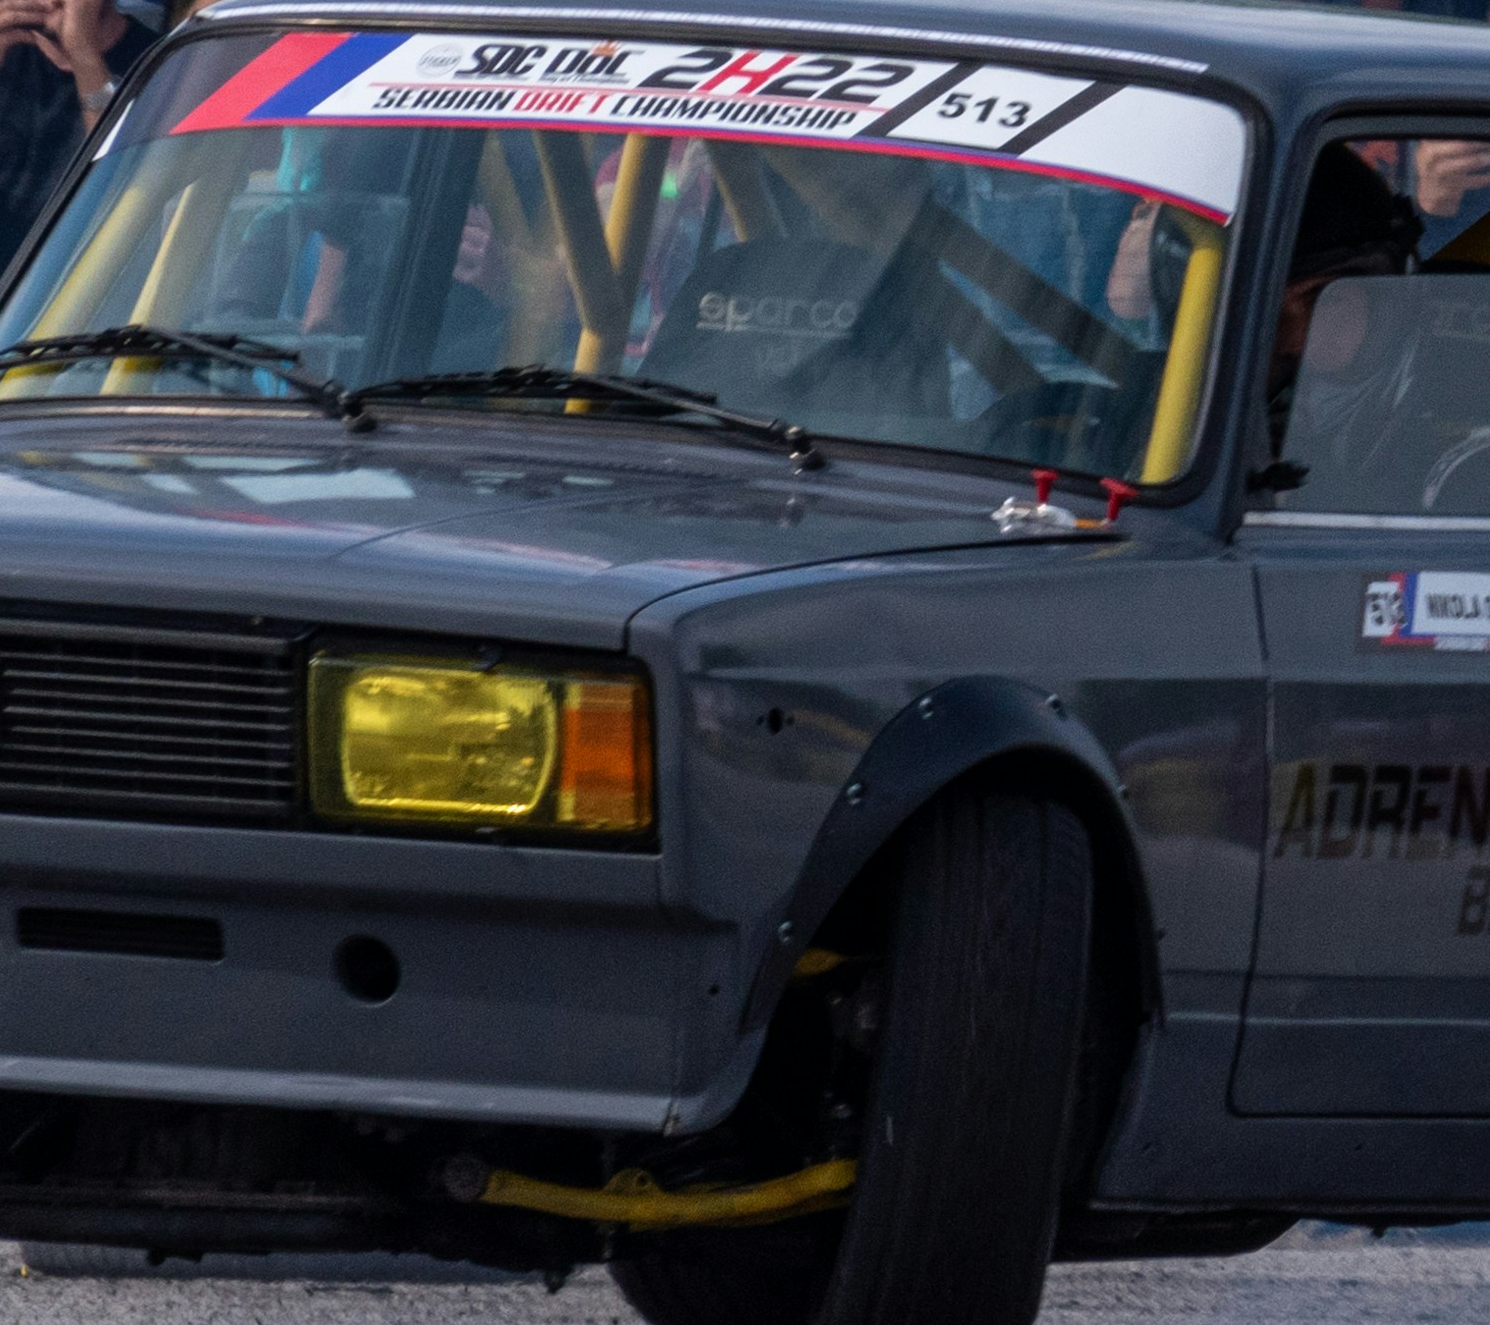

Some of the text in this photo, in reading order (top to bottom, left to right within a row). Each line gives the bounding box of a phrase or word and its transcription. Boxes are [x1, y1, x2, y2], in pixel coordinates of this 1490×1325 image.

[371, 87, 858, 130] SERBIAN DRIFT CHAMPIONSHIP
[937, 91, 1032, 128] 513
